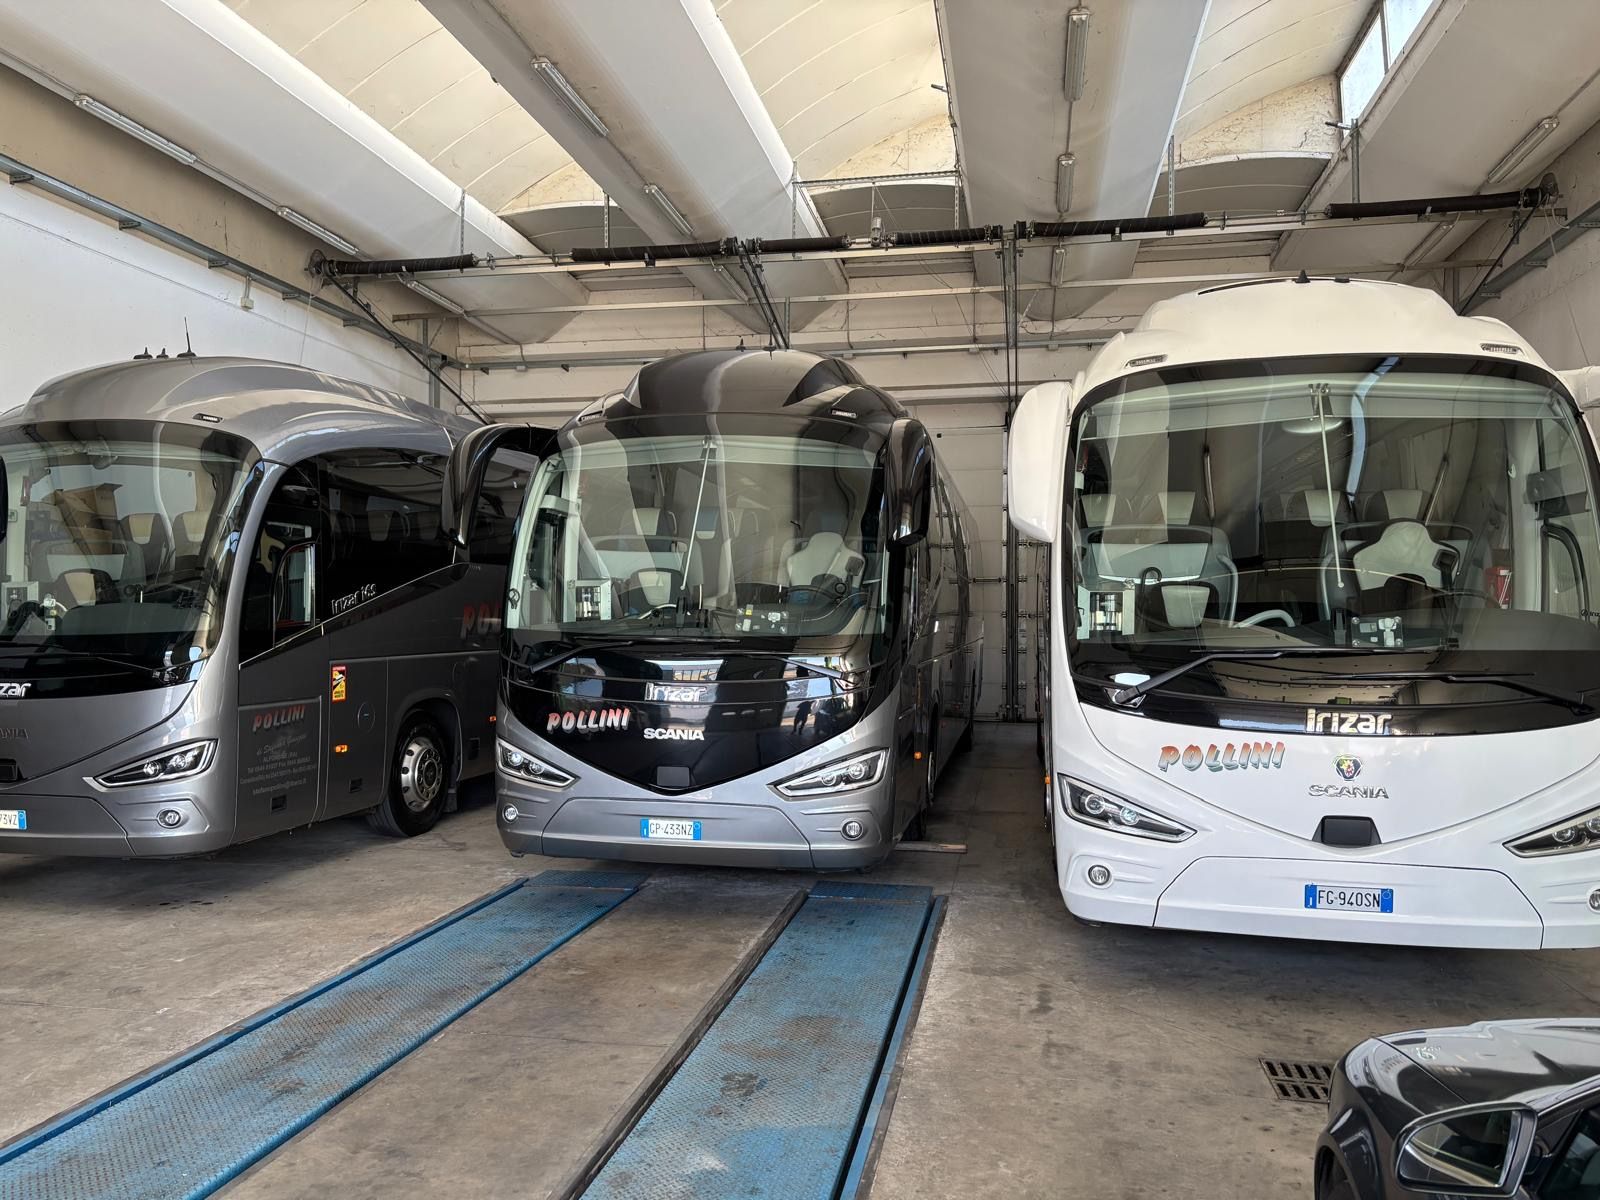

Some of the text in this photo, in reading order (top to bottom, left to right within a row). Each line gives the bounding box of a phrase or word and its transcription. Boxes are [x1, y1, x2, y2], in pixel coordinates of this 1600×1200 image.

[252, 704, 306, 733] POLLINI
[546, 707, 631, 734] POLLINI
[1306, 708, 1393, 734] Irizar
[643, 727, 704, 741] SCANIA
[1157, 741, 1286, 773] POLLINI
[1308, 784, 1390, 799] SCANIA
